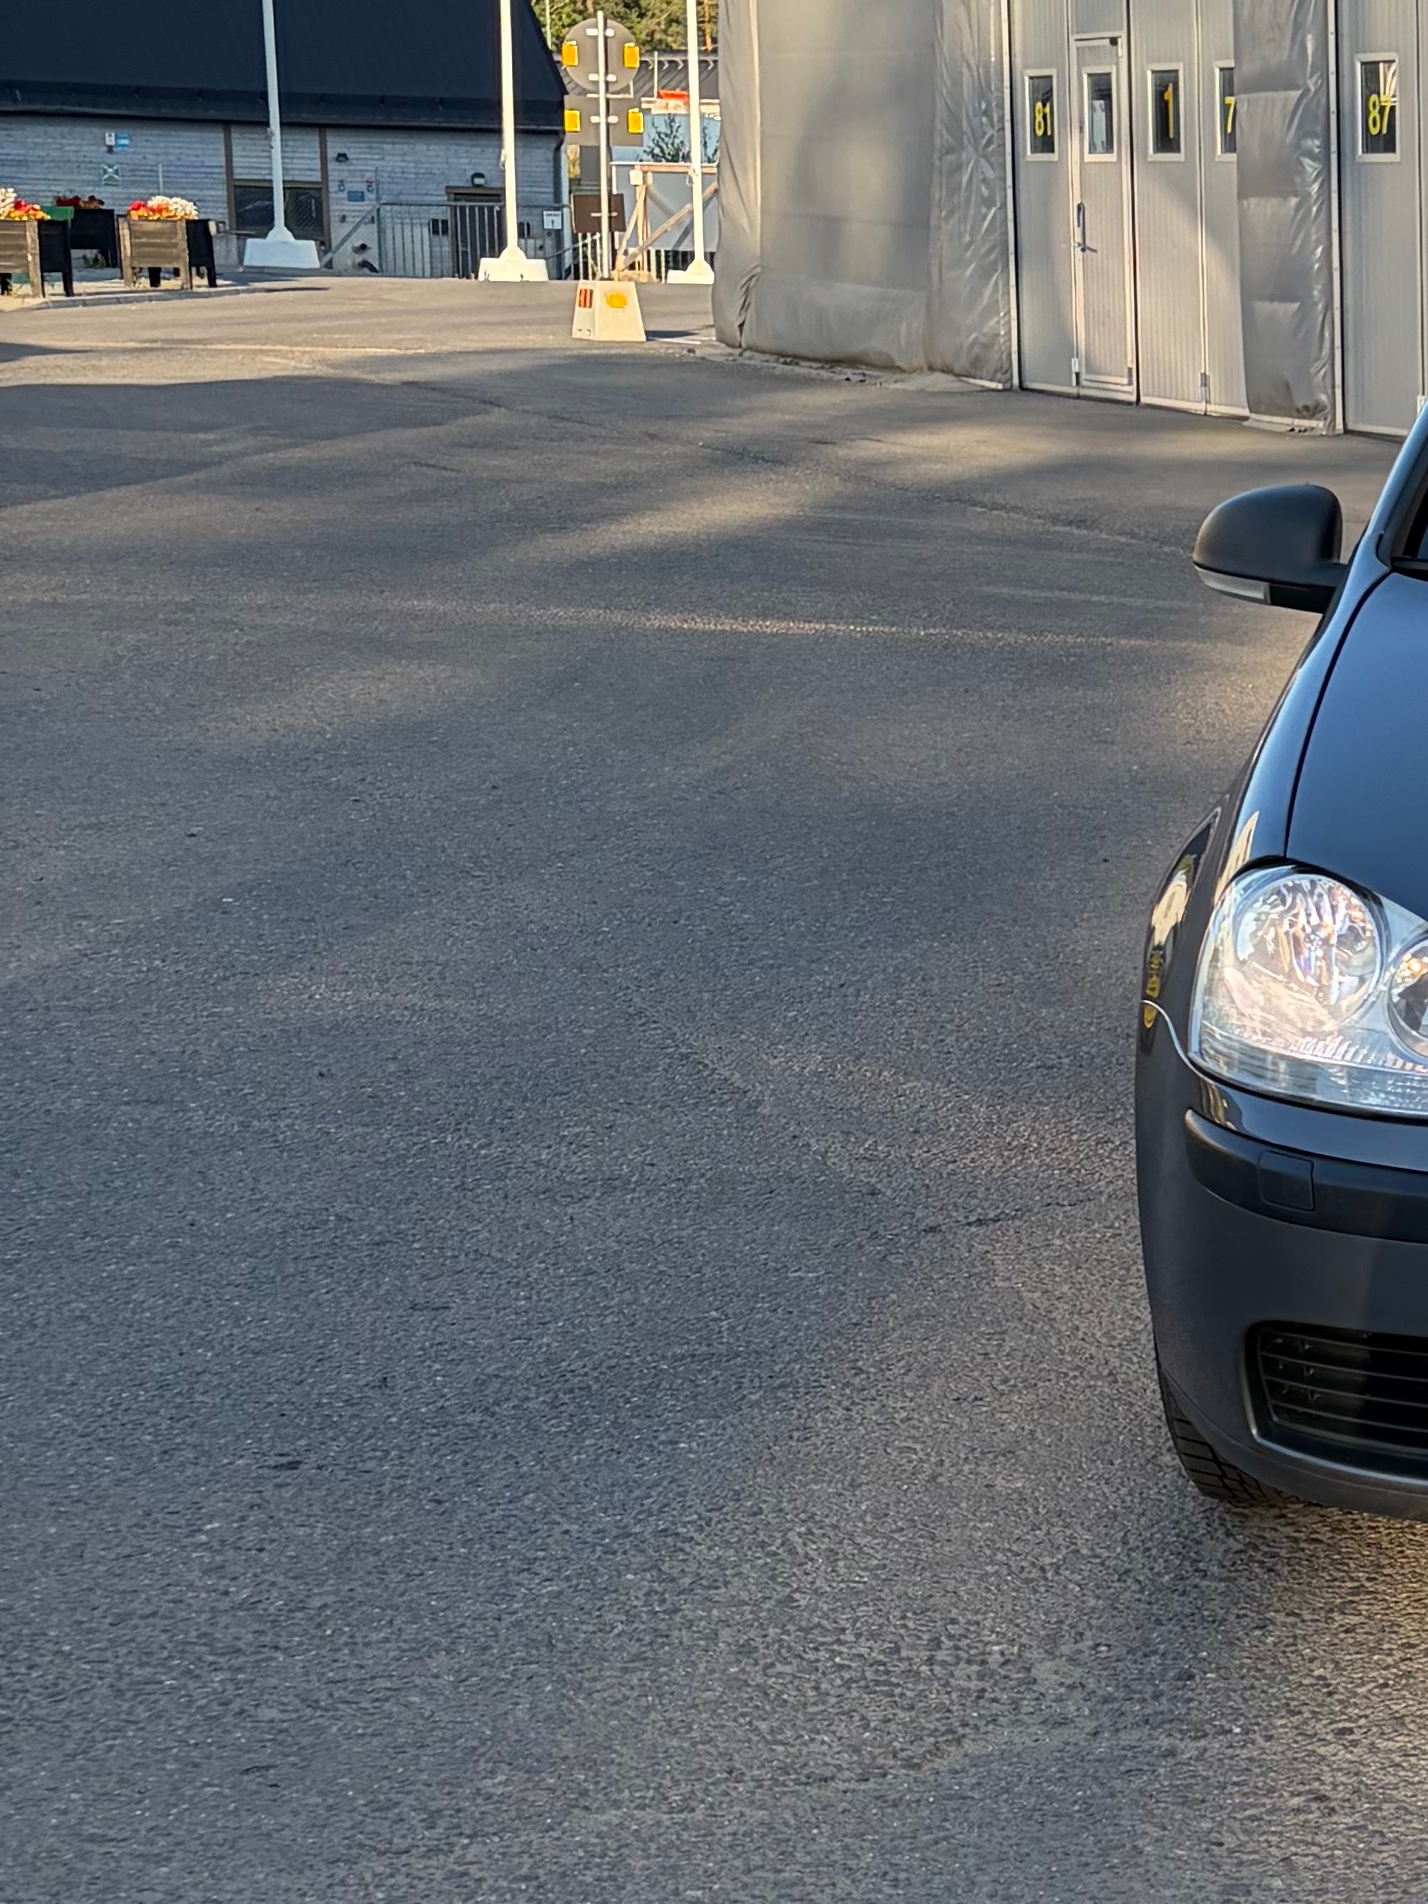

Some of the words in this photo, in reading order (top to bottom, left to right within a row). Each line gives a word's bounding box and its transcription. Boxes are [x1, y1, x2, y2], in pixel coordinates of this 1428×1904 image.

[1034, 101, 1052, 137] 81
[1163, 82, 1175, 139] 1
[1367, 93, 1392, 137] 87
